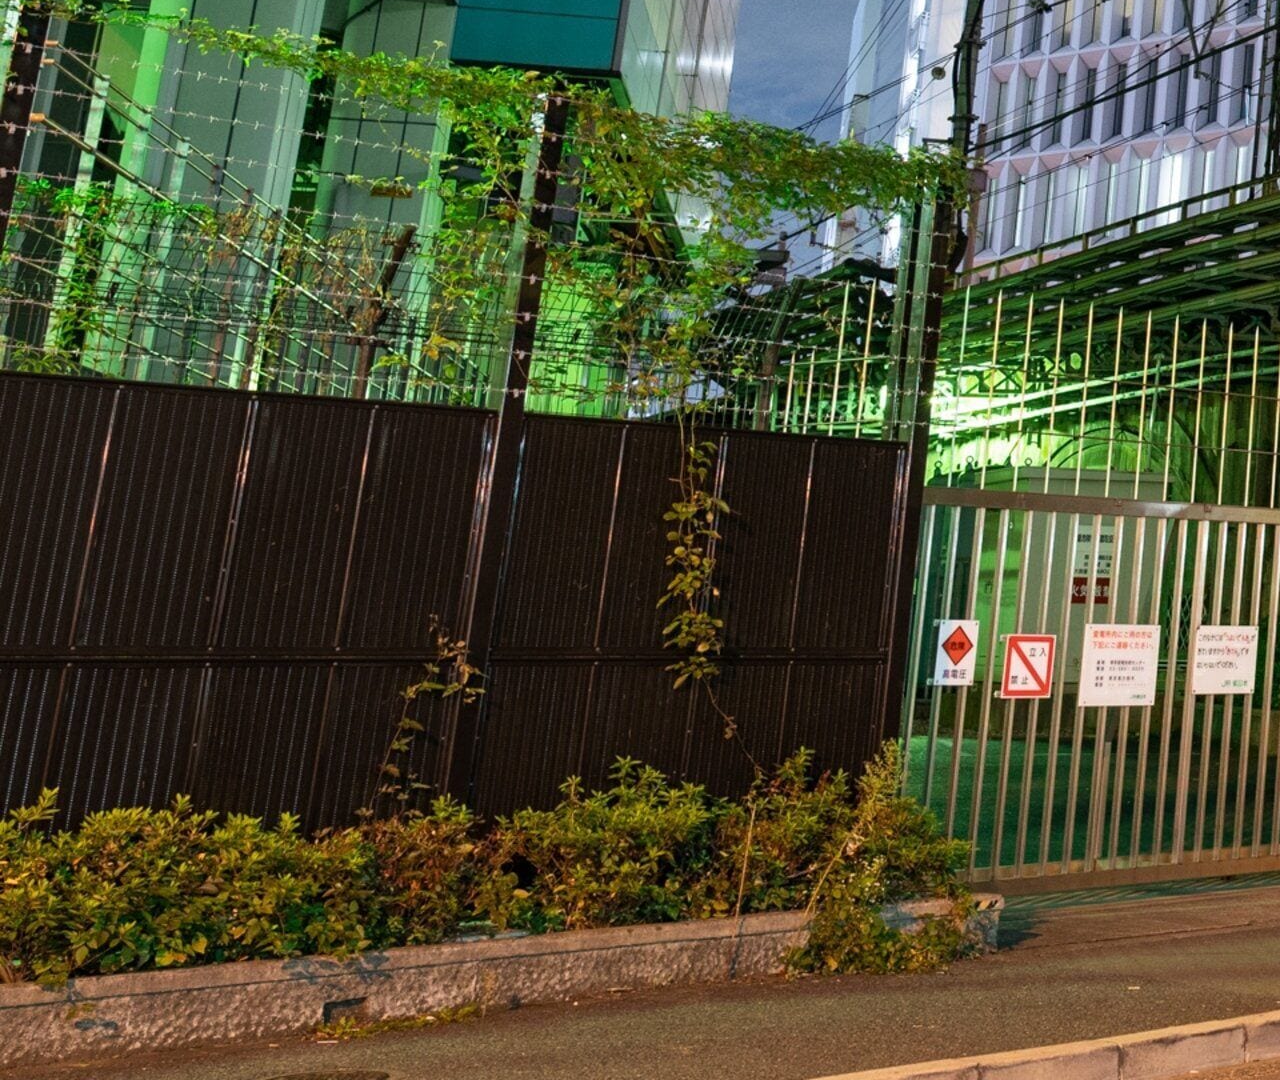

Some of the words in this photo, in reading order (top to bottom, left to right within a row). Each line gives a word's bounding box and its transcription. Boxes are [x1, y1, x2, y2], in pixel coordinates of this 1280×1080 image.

[1029, 647, 1047, 658] 立入
[942, 668, 967, 680] 高電圧
